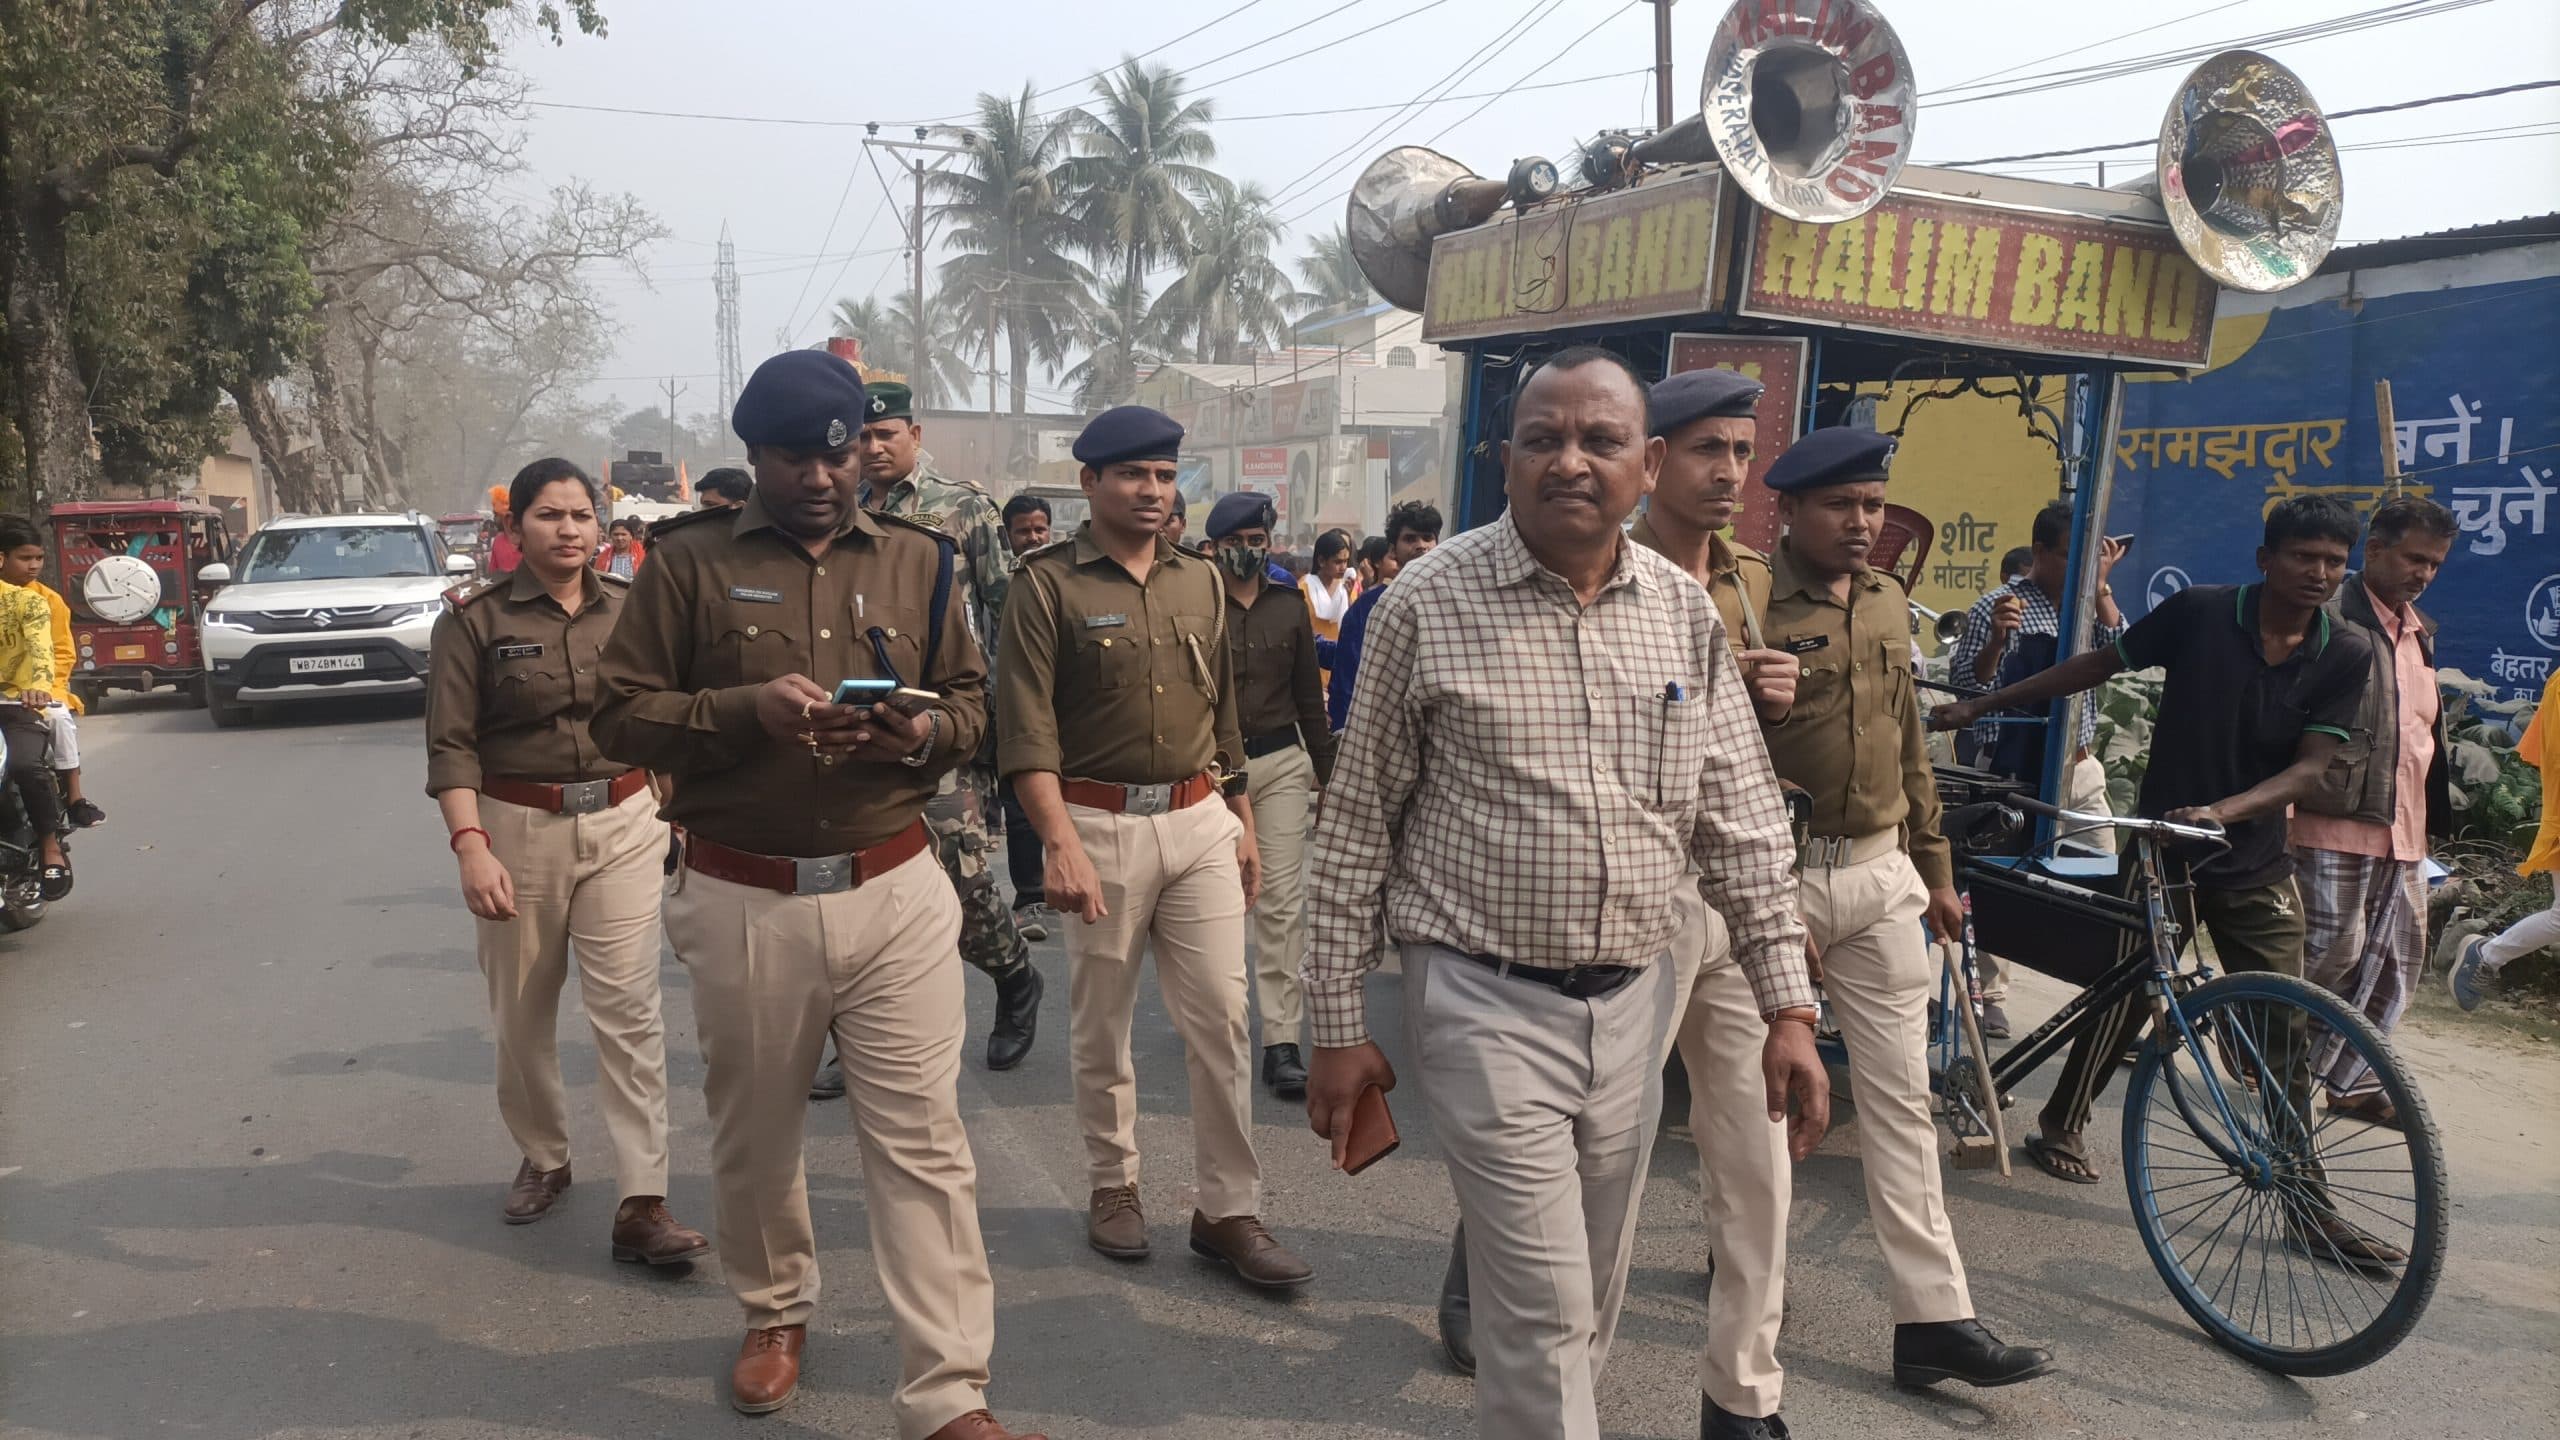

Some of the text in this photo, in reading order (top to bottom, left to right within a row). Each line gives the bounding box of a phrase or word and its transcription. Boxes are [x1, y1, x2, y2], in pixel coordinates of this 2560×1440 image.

[1825, 52, 1902, 202] BAND
[1568, 198, 1713, 308] BAND
[1763, 211, 2198, 342] HALIM BAND
[2117, 418, 2348, 479] समझदार
[1940, 511, 1998, 556] शीट
[1934, 559, 1990, 594] मोटाई
